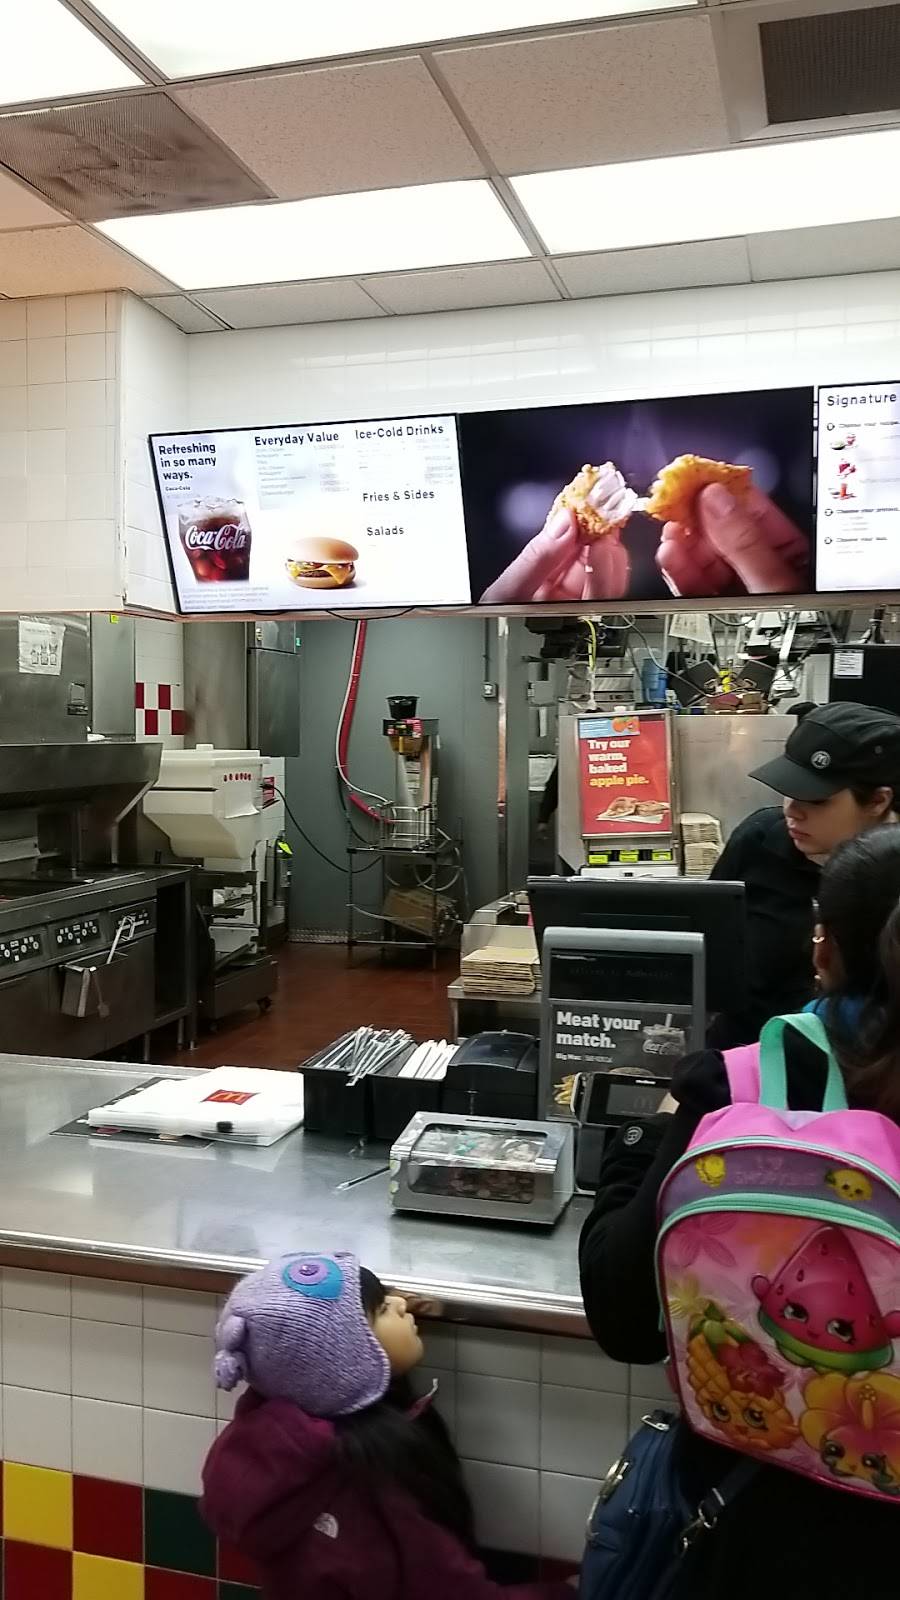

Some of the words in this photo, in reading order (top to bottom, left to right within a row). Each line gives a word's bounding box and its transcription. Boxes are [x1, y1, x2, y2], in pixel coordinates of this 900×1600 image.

[826, 394, 898, 408] Signature
[355, 427, 403, 439] Ice-Cold
[406, 424, 444, 436] Drinks
[254, 433, 304, 446] Everyday
[307, 431, 339, 443] Value
[158, 443, 217, 456] Refreshing
[160, 458, 171, 468] in
[173, 459, 186, 467] so
[188, 457, 217, 468] many
[163, 471, 193, 481] ways.
[362, 492, 390, 502] Fries
[393, 491, 401, 501] &
[404, 490, 435, 500] Sides
[185, 523, 247, 551] Coca-Cola
[366, 526, 405, 536] Salads
[587, 739, 609, 751] Try
[609, 739, 631, 750] our
[588, 752, 627, 762] warm,
[588, 763, 627, 774] baked
[589, 775, 625, 787] apple
[625, 774, 650, 786] pie.
[556, 1011, 600, 1028] Meat
[601, 1015, 642, 1031] your
[556, 1033, 617, 1049] match.
